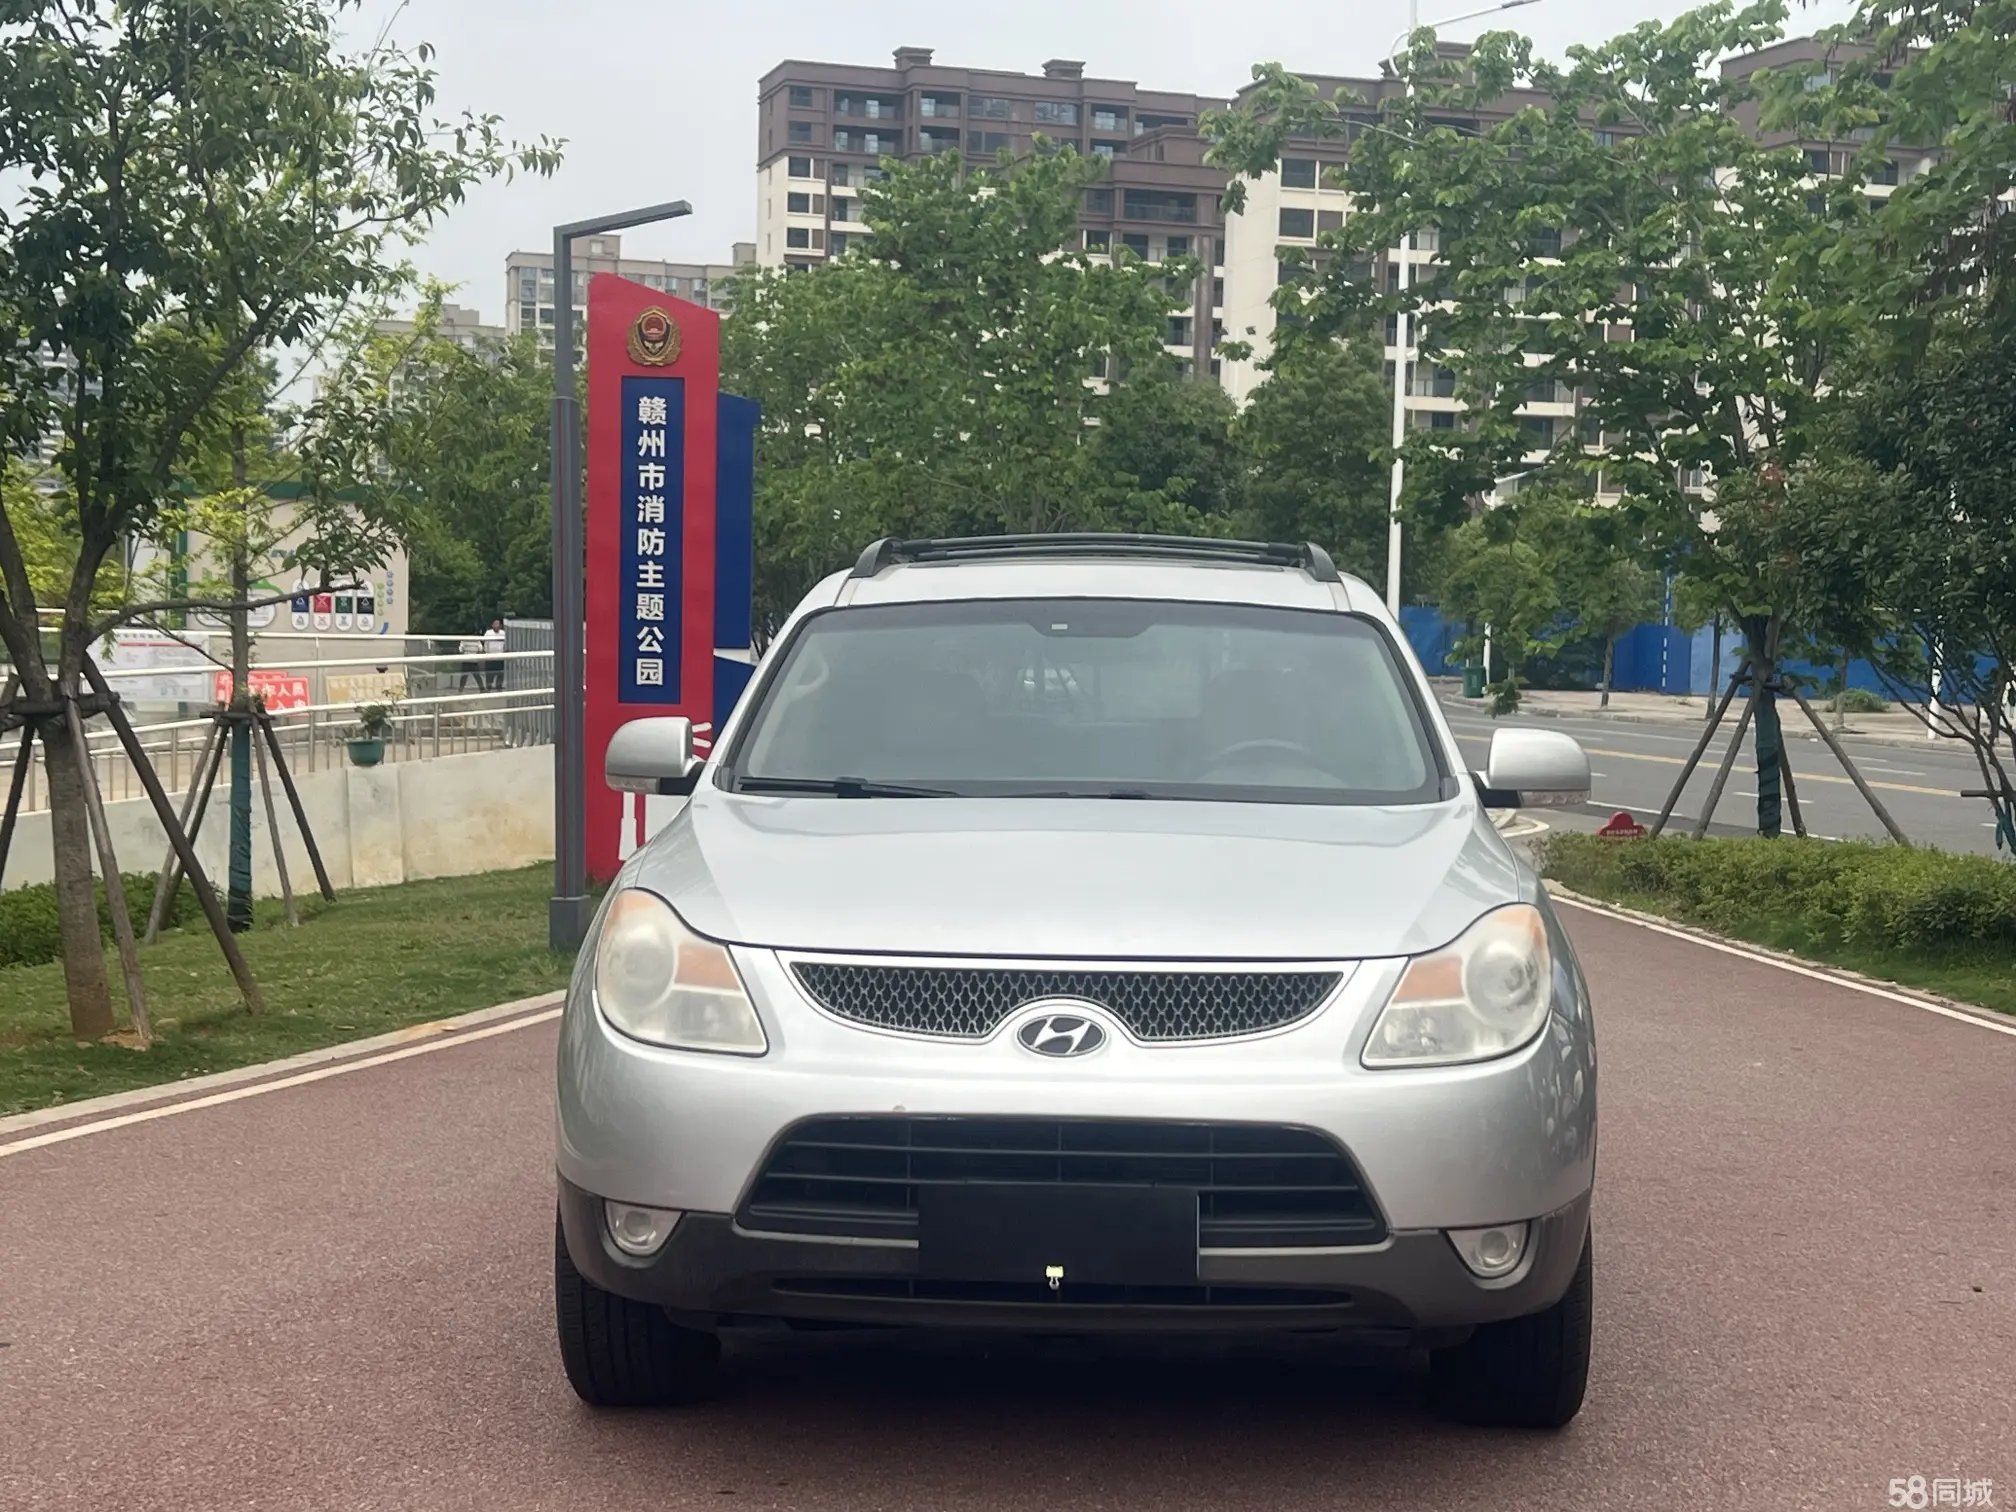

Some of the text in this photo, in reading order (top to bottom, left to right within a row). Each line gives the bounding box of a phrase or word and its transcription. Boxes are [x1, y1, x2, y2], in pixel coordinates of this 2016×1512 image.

[637, 396, 667, 686] 赣州市消防主题公园
